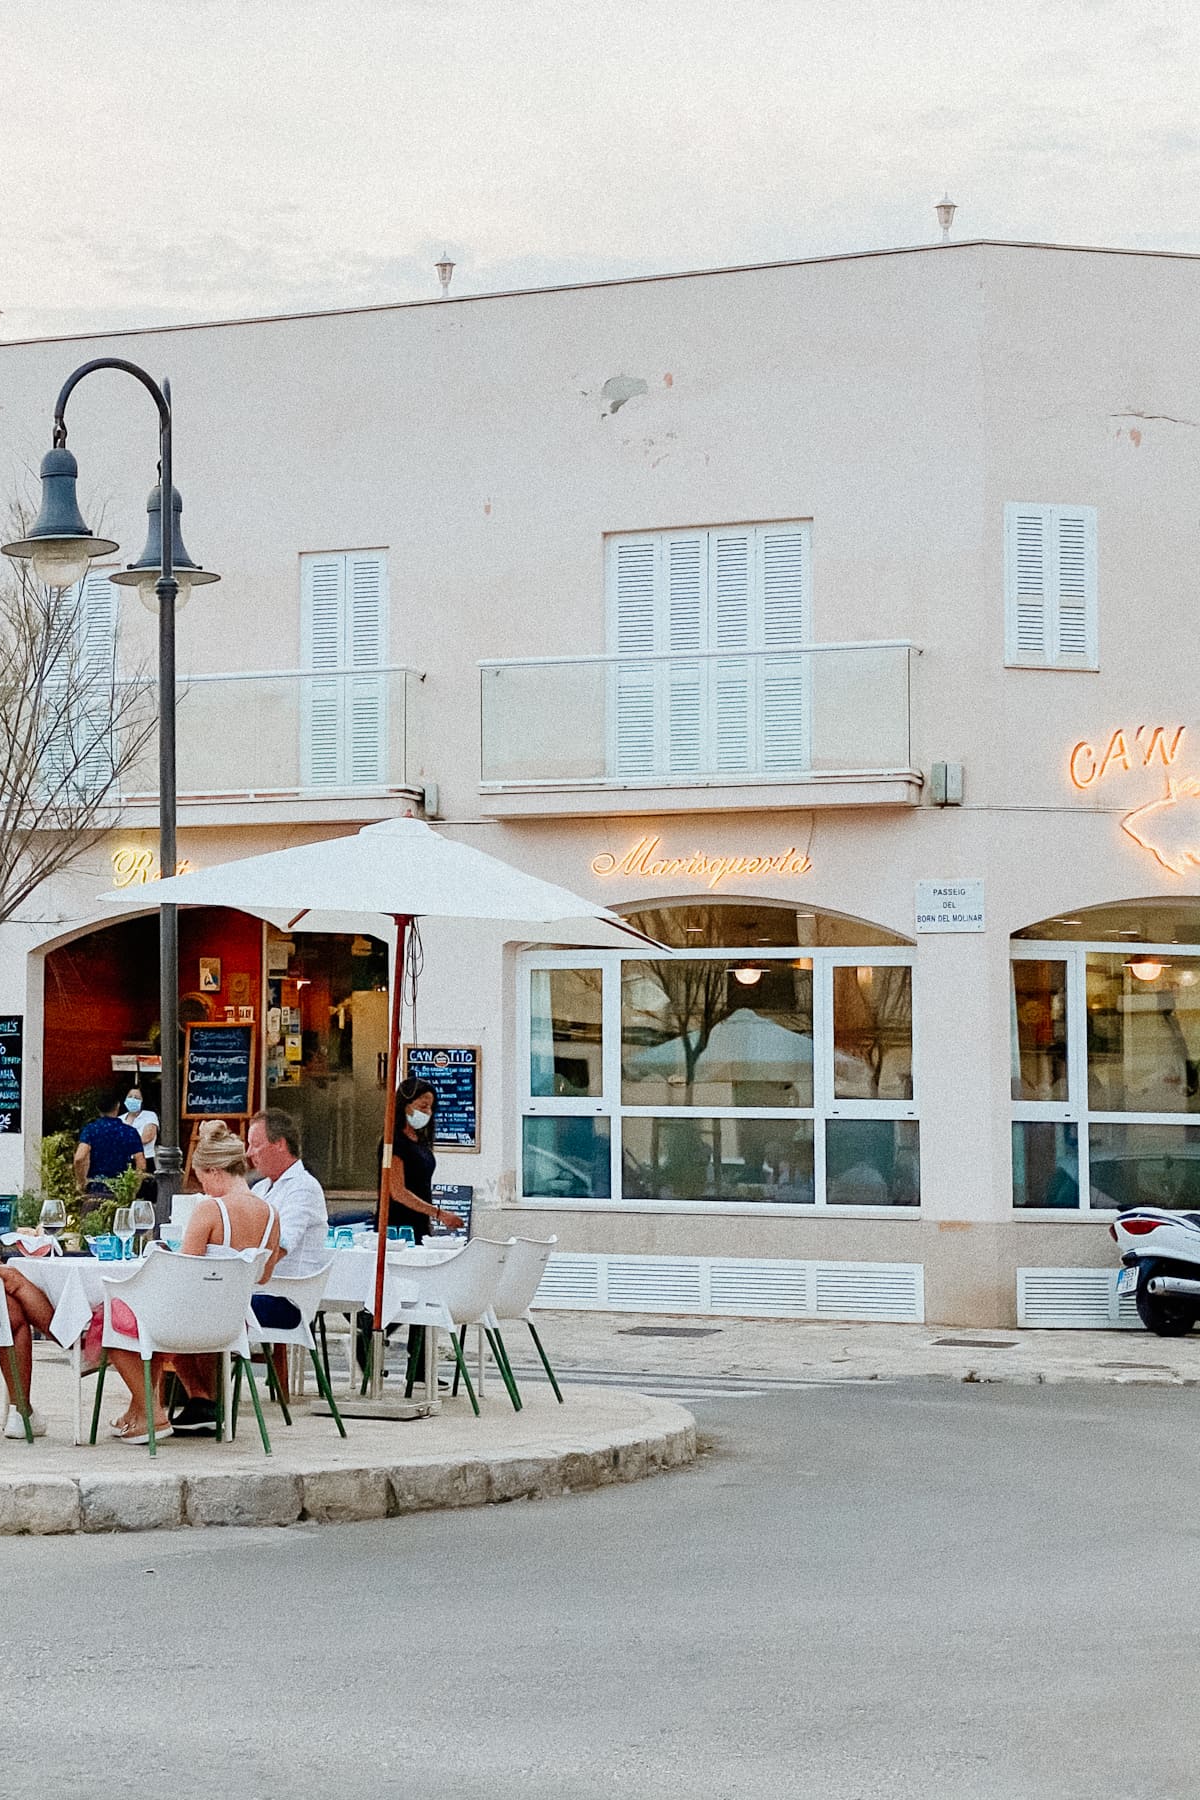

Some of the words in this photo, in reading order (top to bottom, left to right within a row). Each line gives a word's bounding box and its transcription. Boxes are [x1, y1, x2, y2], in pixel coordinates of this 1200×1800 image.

[1070, 724, 1187, 790] CA'N
[932, 888, 966, 896] PASSEIG
[942, 901, 956, 909] DEL
[917, 914, 936, 923] BORN
[938, 914, 951, 923] DEL
[952, 914, 983, 922] MOLINAR
[409, 1050, 433, 1062] CA'N
[447, 1049, 473, 1062] TITO
